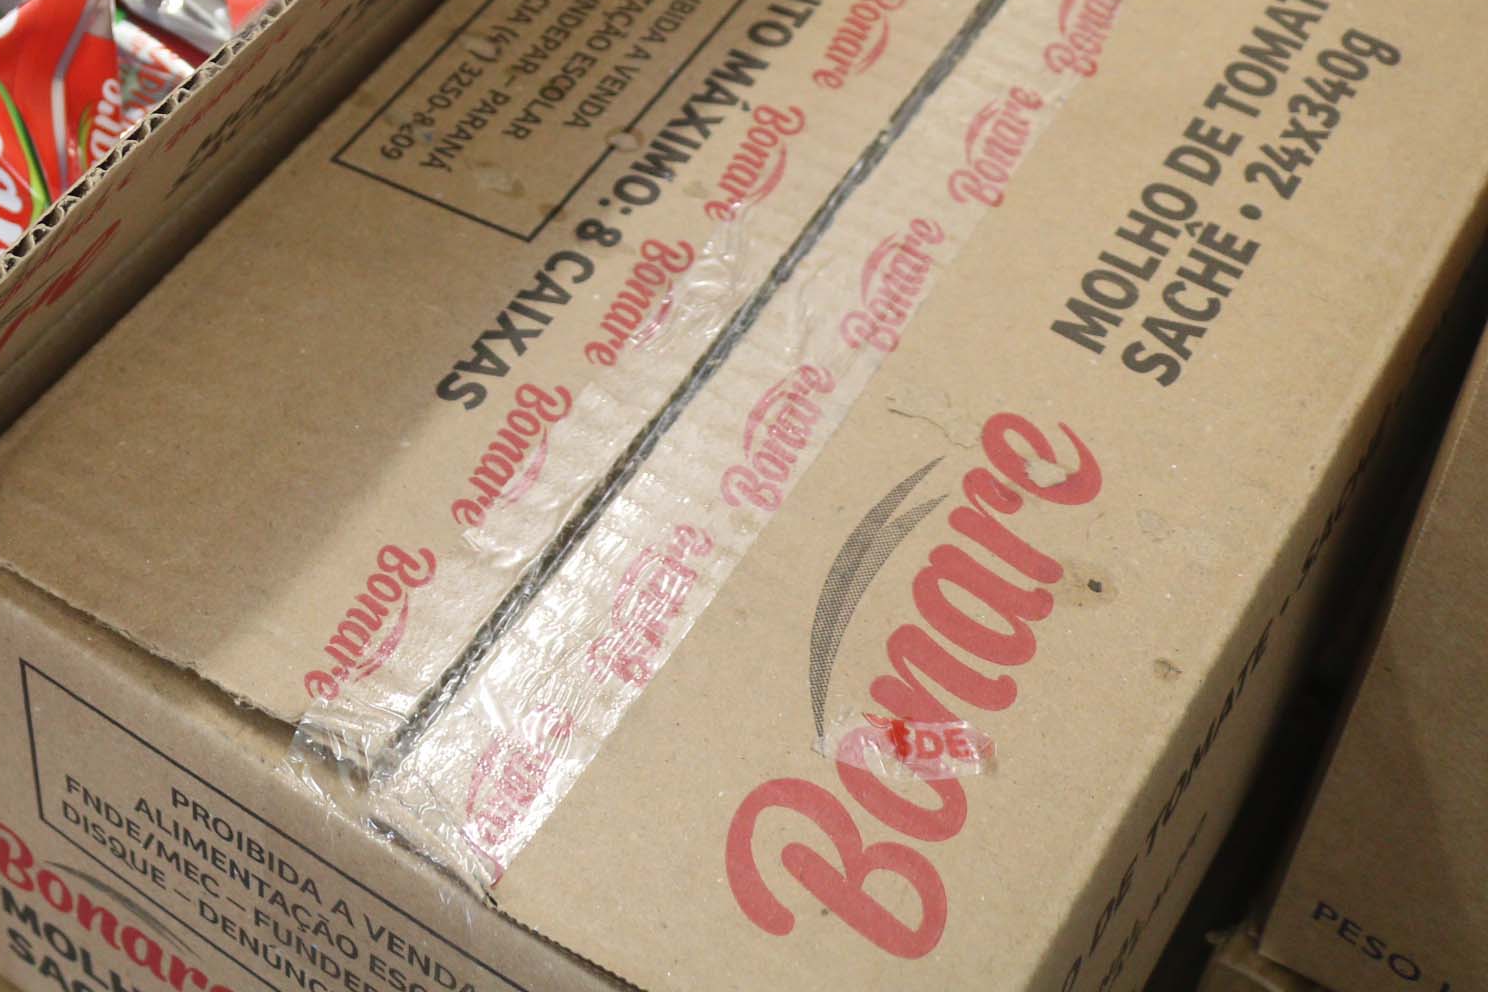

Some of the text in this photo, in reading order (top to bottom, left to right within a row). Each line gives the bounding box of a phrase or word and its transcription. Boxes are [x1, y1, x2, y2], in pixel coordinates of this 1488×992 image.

[502, 51, 599, 142] ESCOLAR
[562, 64, 641, 130] VENDA
[629, 44, 654, 63] A
[418, 89, 512, 174] PARANÁ
[596, 46, 770, 218] MÁXIMO:
[704, 104, 806, 223] Bonare
[948, 86, 1044, 209] Bonare
[575, 218, 624, 249] 8
[1049, 181, 1200, 356] MOLHO
[1163, 116, 1245, 187] DE
[435, 248, 596, 412] CAIXAS
[583, 238, 695, 368] Bonare
[1120, 220, 1263, 388] SACHÊ
[450, 383, 574, 530] Bonare
[304, 543, 437, 703] Bonare
[724, 410, 1104, 961] Bonare
[62, 800, 168, 892] DISQUE
[198, 899, 330, 992] DENÚNC
[65, 772, 221, 901] FNDE/MEC
[133, 796, 360, 962] ALIMENTAÇÃO
[169, 785, 323, 904] PROIBIDA
[330, 899, 356, 928] A
[0, 885, 150, 992] MOL
[1313, 901, 1423, 985] PESO
